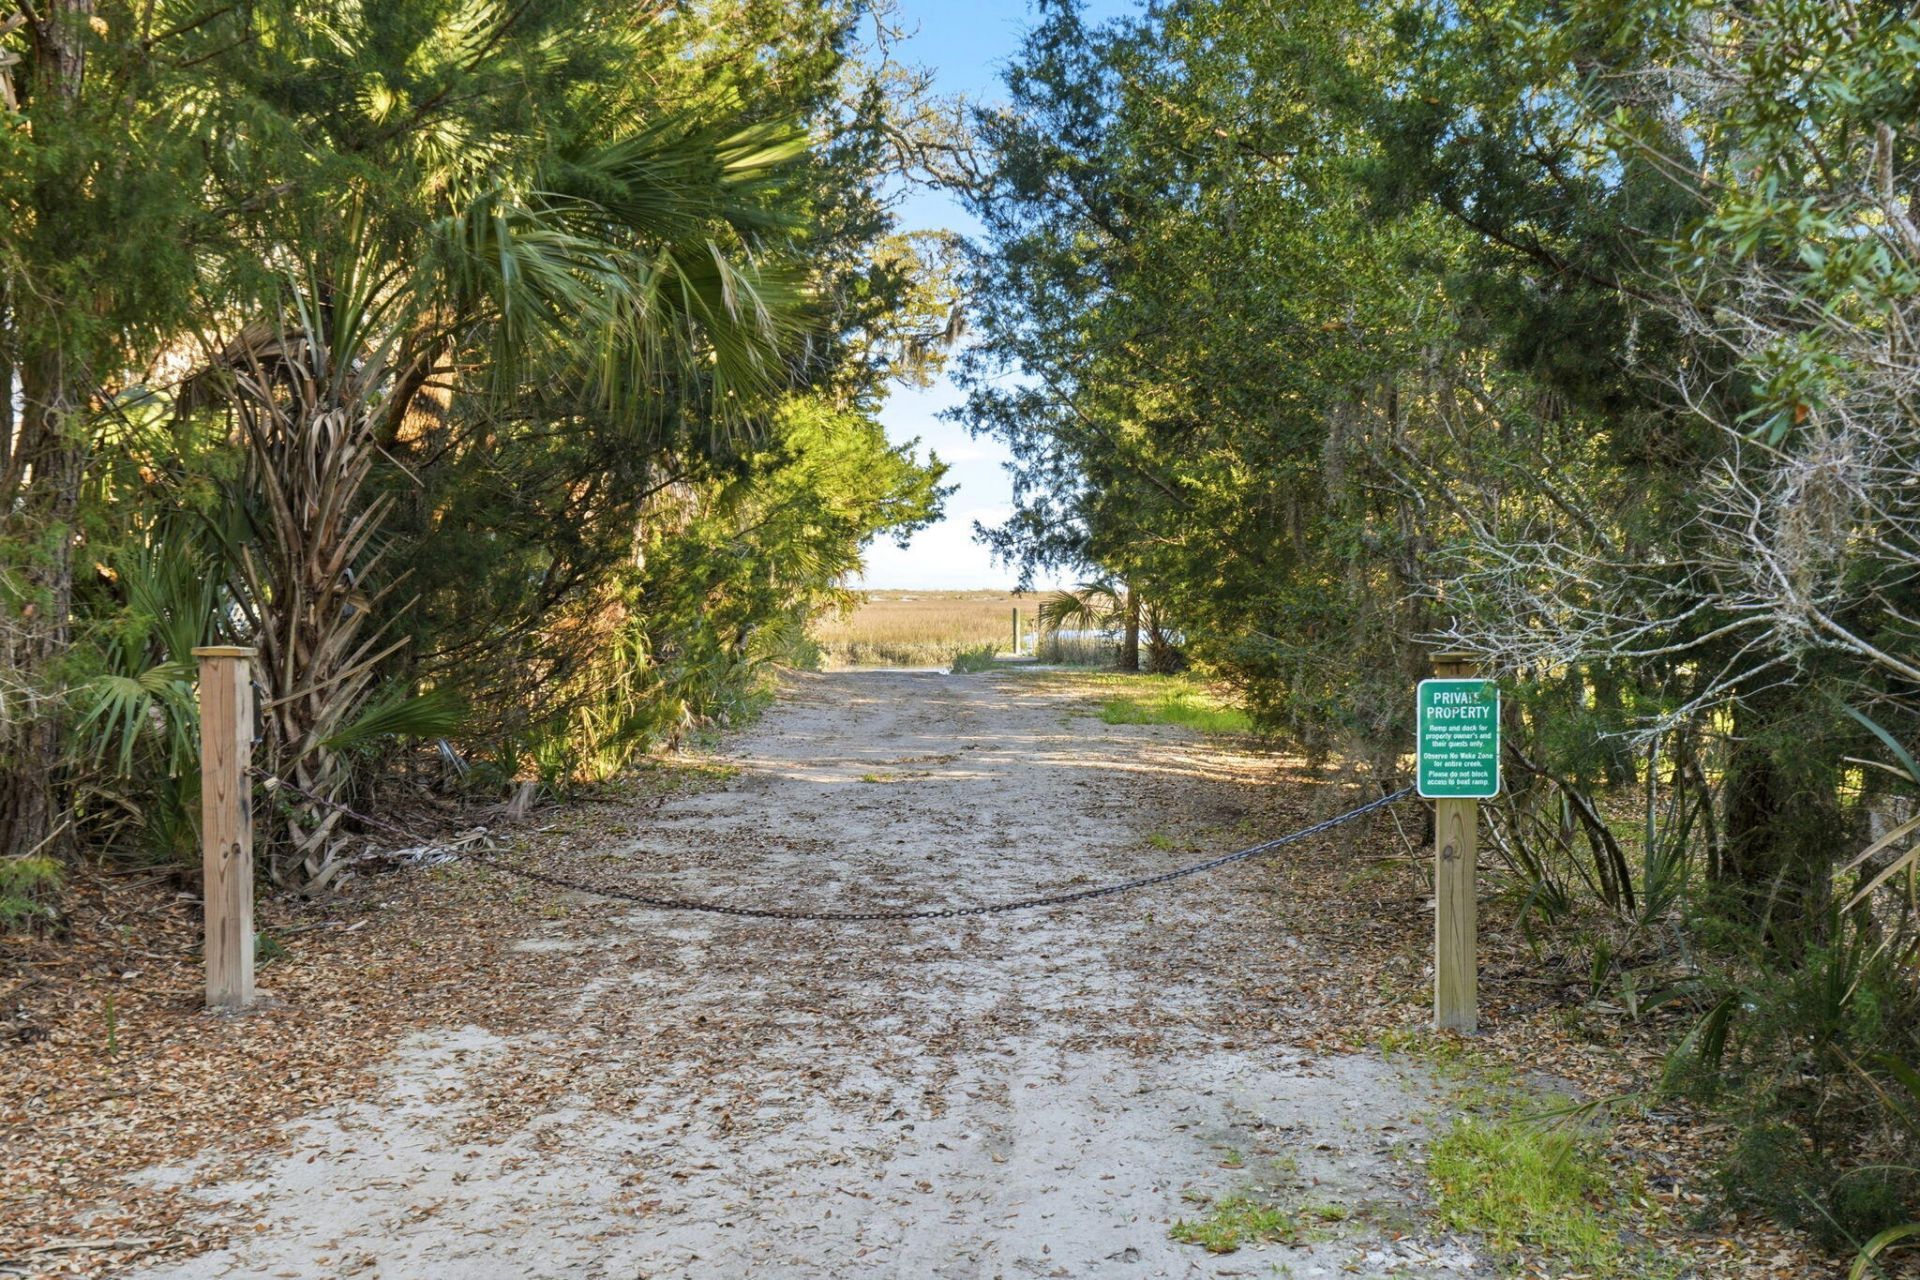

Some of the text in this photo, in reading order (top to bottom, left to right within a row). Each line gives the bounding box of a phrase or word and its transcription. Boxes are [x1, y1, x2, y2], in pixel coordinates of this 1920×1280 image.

[1427, 706, 1490, 719] PROPERTY
[1429, 724, 1447, 732] Ramp
[1479, 724, 1488, 732] for
[1425, 733, 1452, 741] property
[1448, 741, 1468, 749] guests
